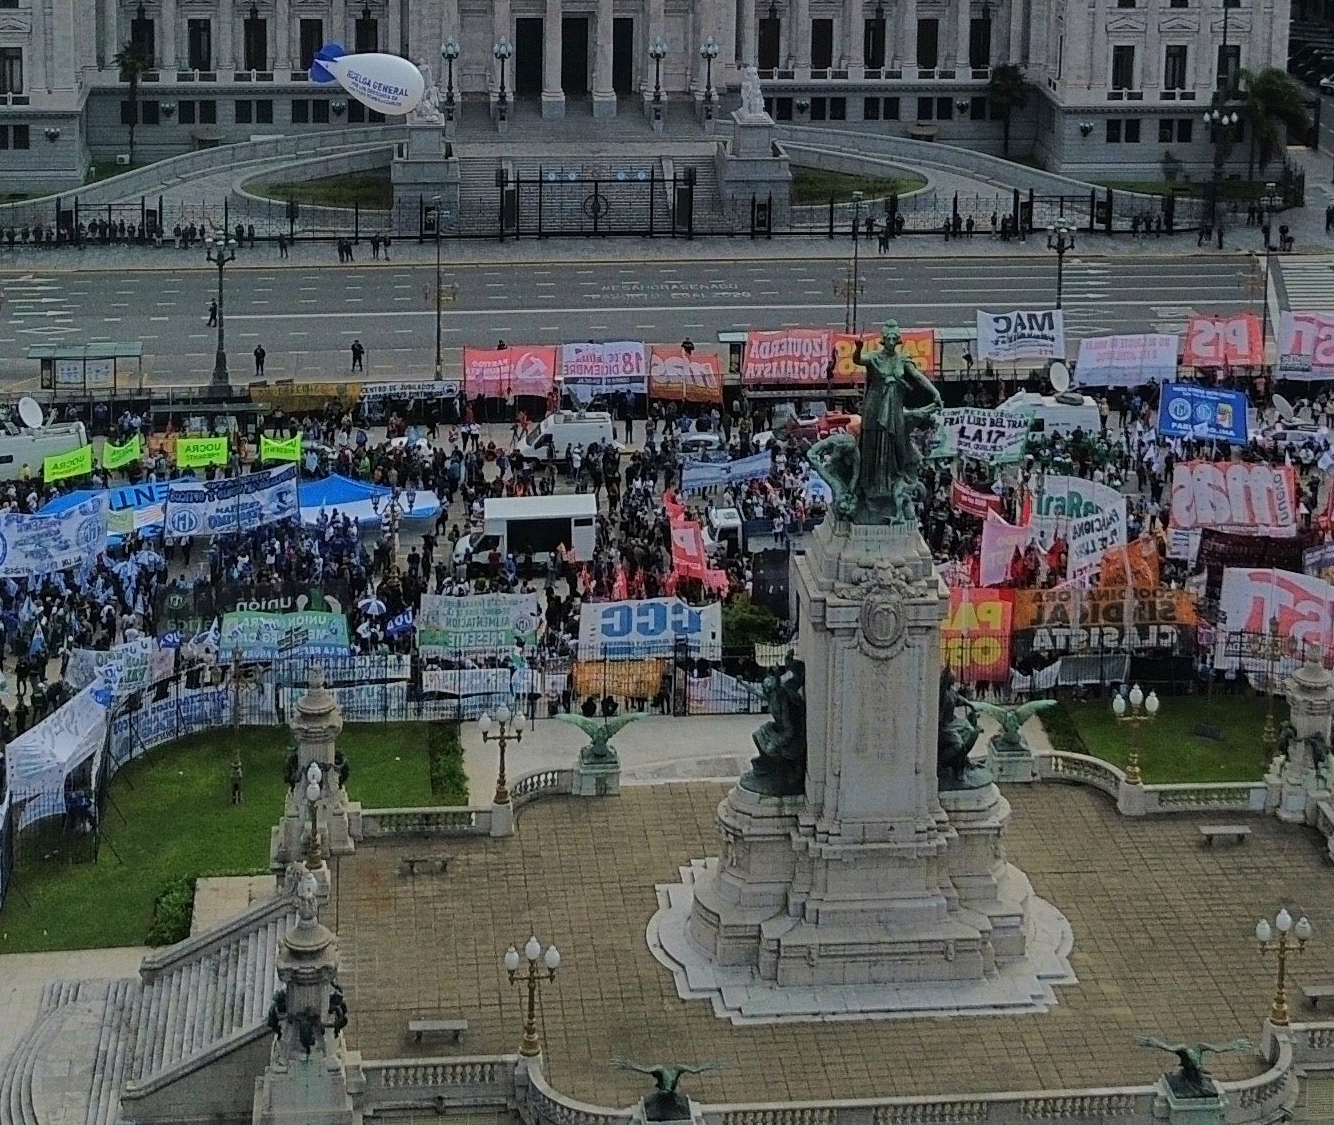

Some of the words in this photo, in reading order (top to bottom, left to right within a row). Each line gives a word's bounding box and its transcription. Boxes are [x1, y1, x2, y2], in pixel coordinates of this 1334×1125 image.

[373, 81, 408, 97] GENERAL
[400, 383, 436, 392] JUBILADOS
[943, 416, 965, 427] FRAY
[967, 415, 987, 427] LUIS
[987, 429, 1006, 444] 17
